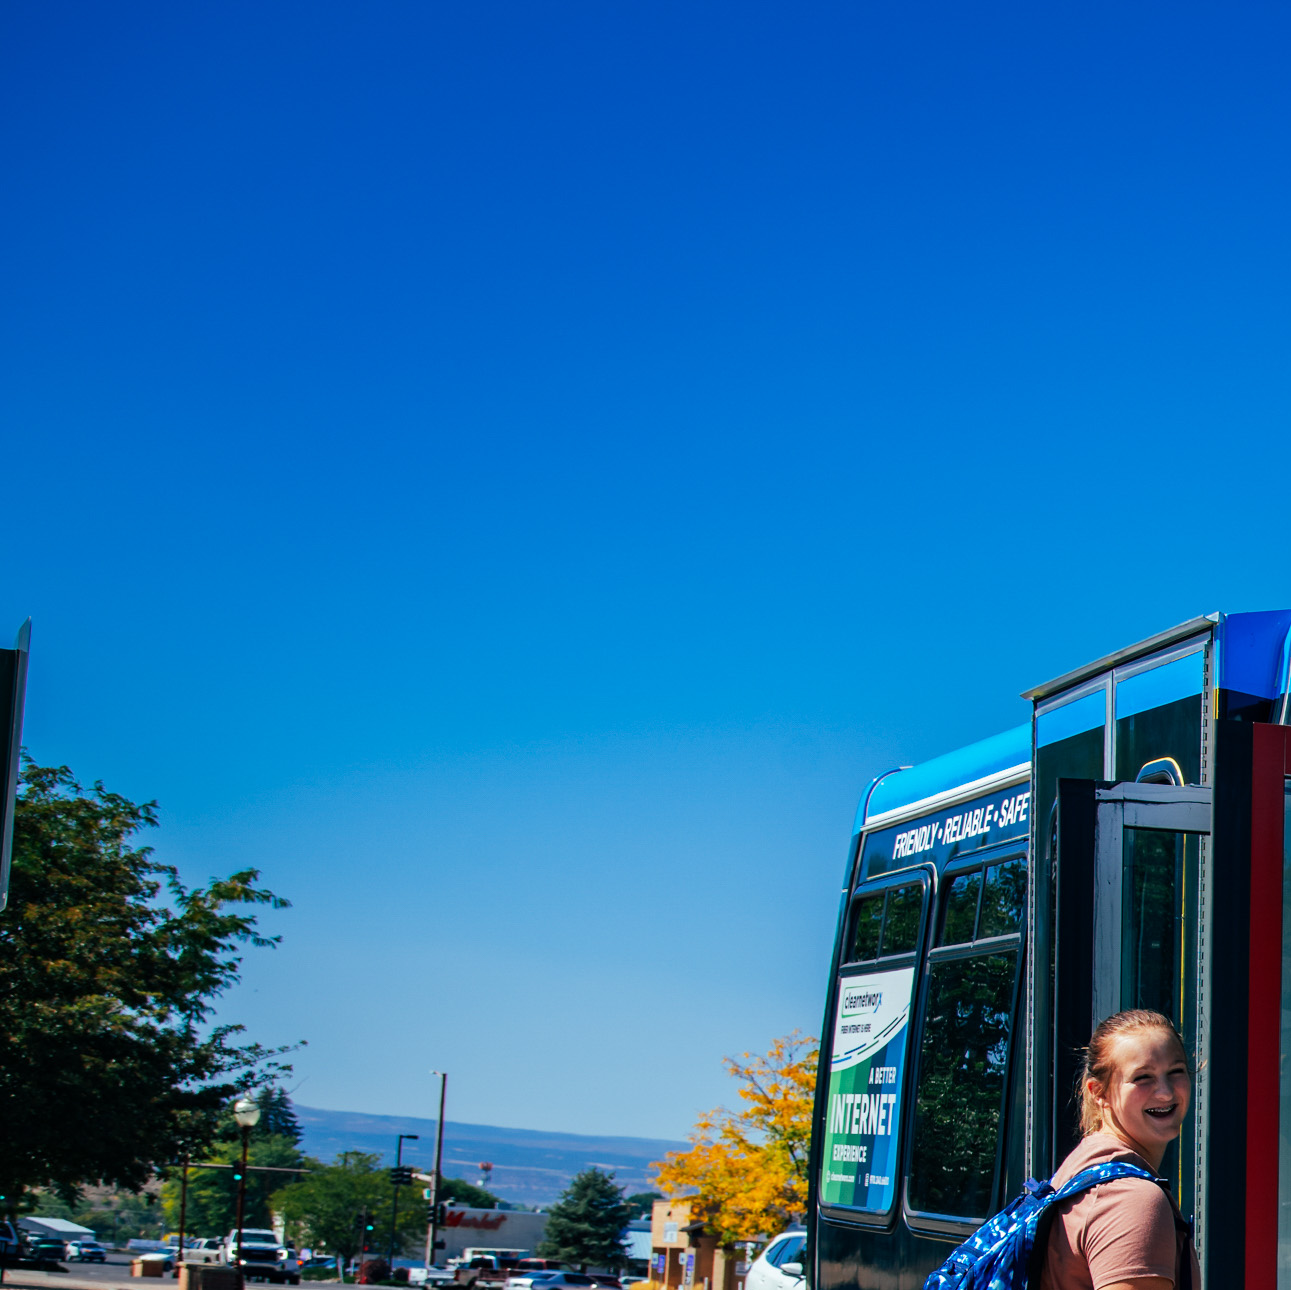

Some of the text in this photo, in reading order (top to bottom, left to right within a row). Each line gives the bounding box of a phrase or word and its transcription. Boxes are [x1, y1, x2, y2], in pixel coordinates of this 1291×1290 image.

[892, 791, 1031, 860] FRIENDLY RELIABLE SAFE
[868, 1067, 897, 1084] A BETTER
[830, 1093, 897, 1135] INTERNET
[832, 1144, 867, 1163] EXPERIENCE
